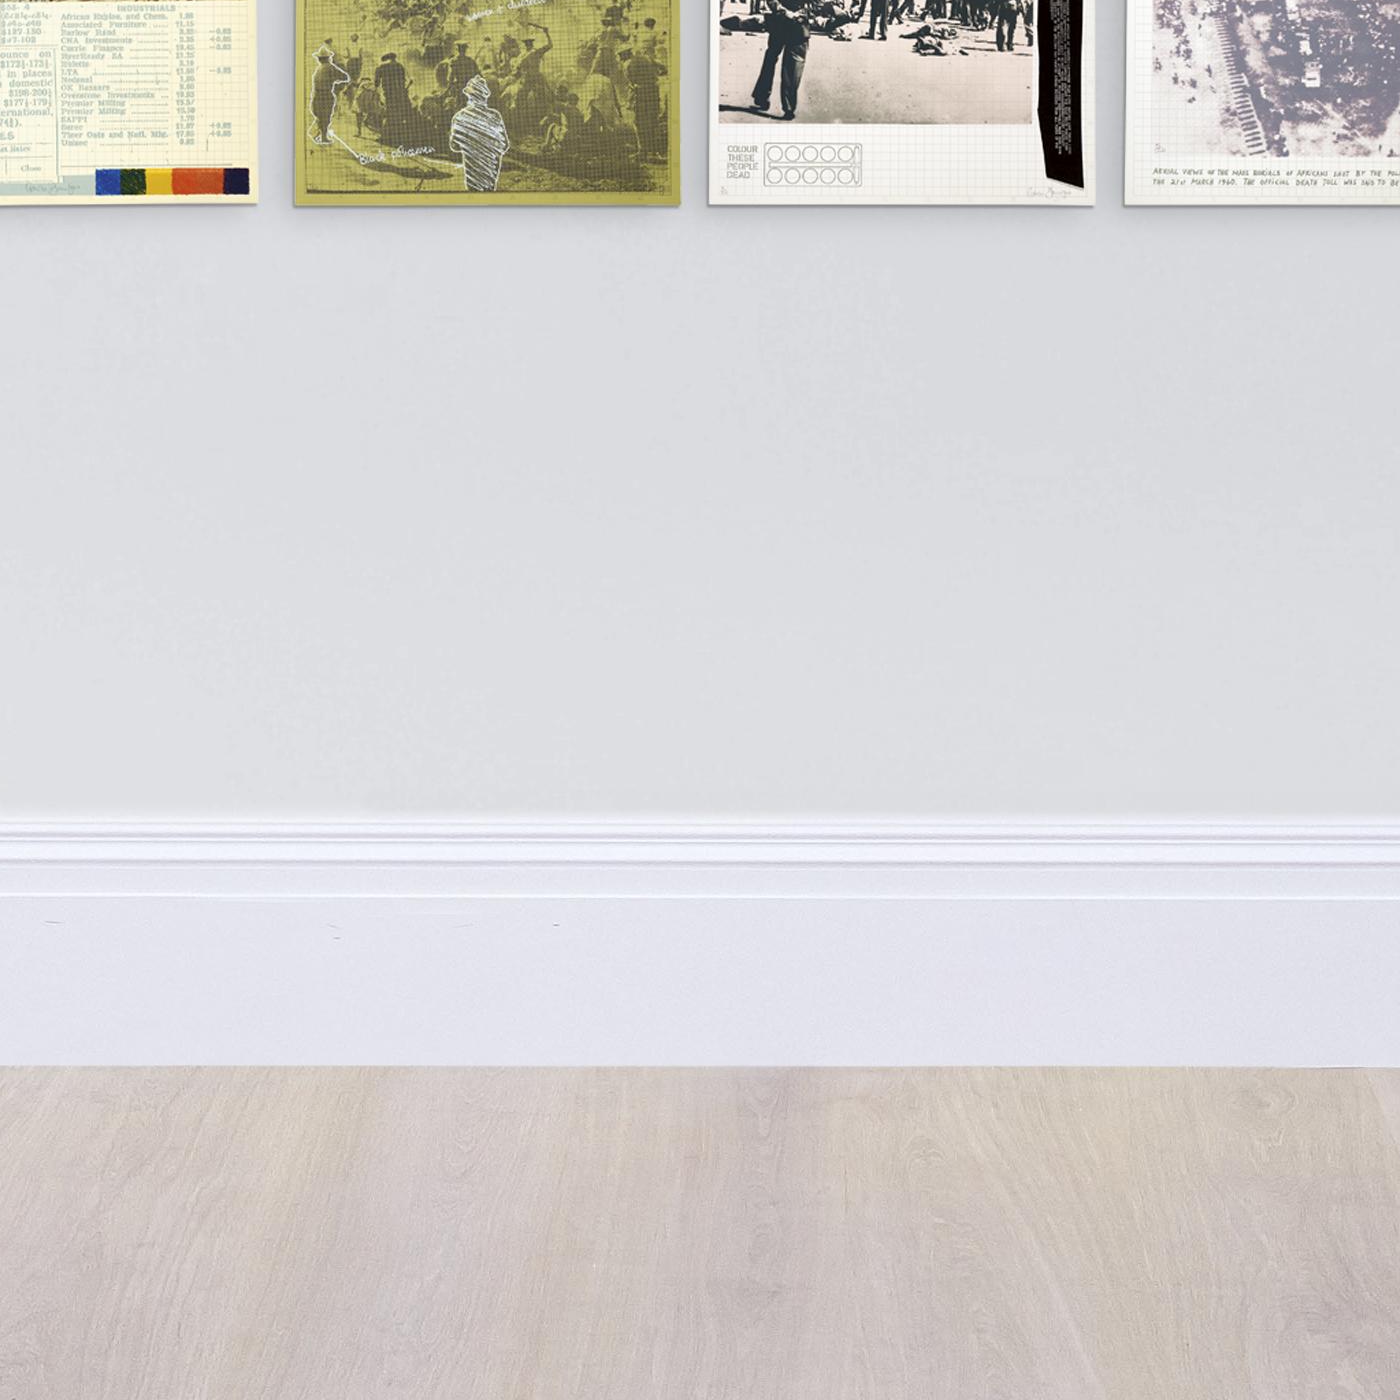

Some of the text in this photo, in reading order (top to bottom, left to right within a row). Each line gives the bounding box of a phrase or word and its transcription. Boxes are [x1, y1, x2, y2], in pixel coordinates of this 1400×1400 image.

[117, 4, 176, 12] INDUSTRIALS
[6, 70, 17, 78] in
[22, 70, 53, 79] places
[728, 145, 758, 153] COLOUR
[728, 154, 755, 162] THESE
[727, 162, 759, 171] PEOPLE
[727, 171, 750, 179] DEAD
